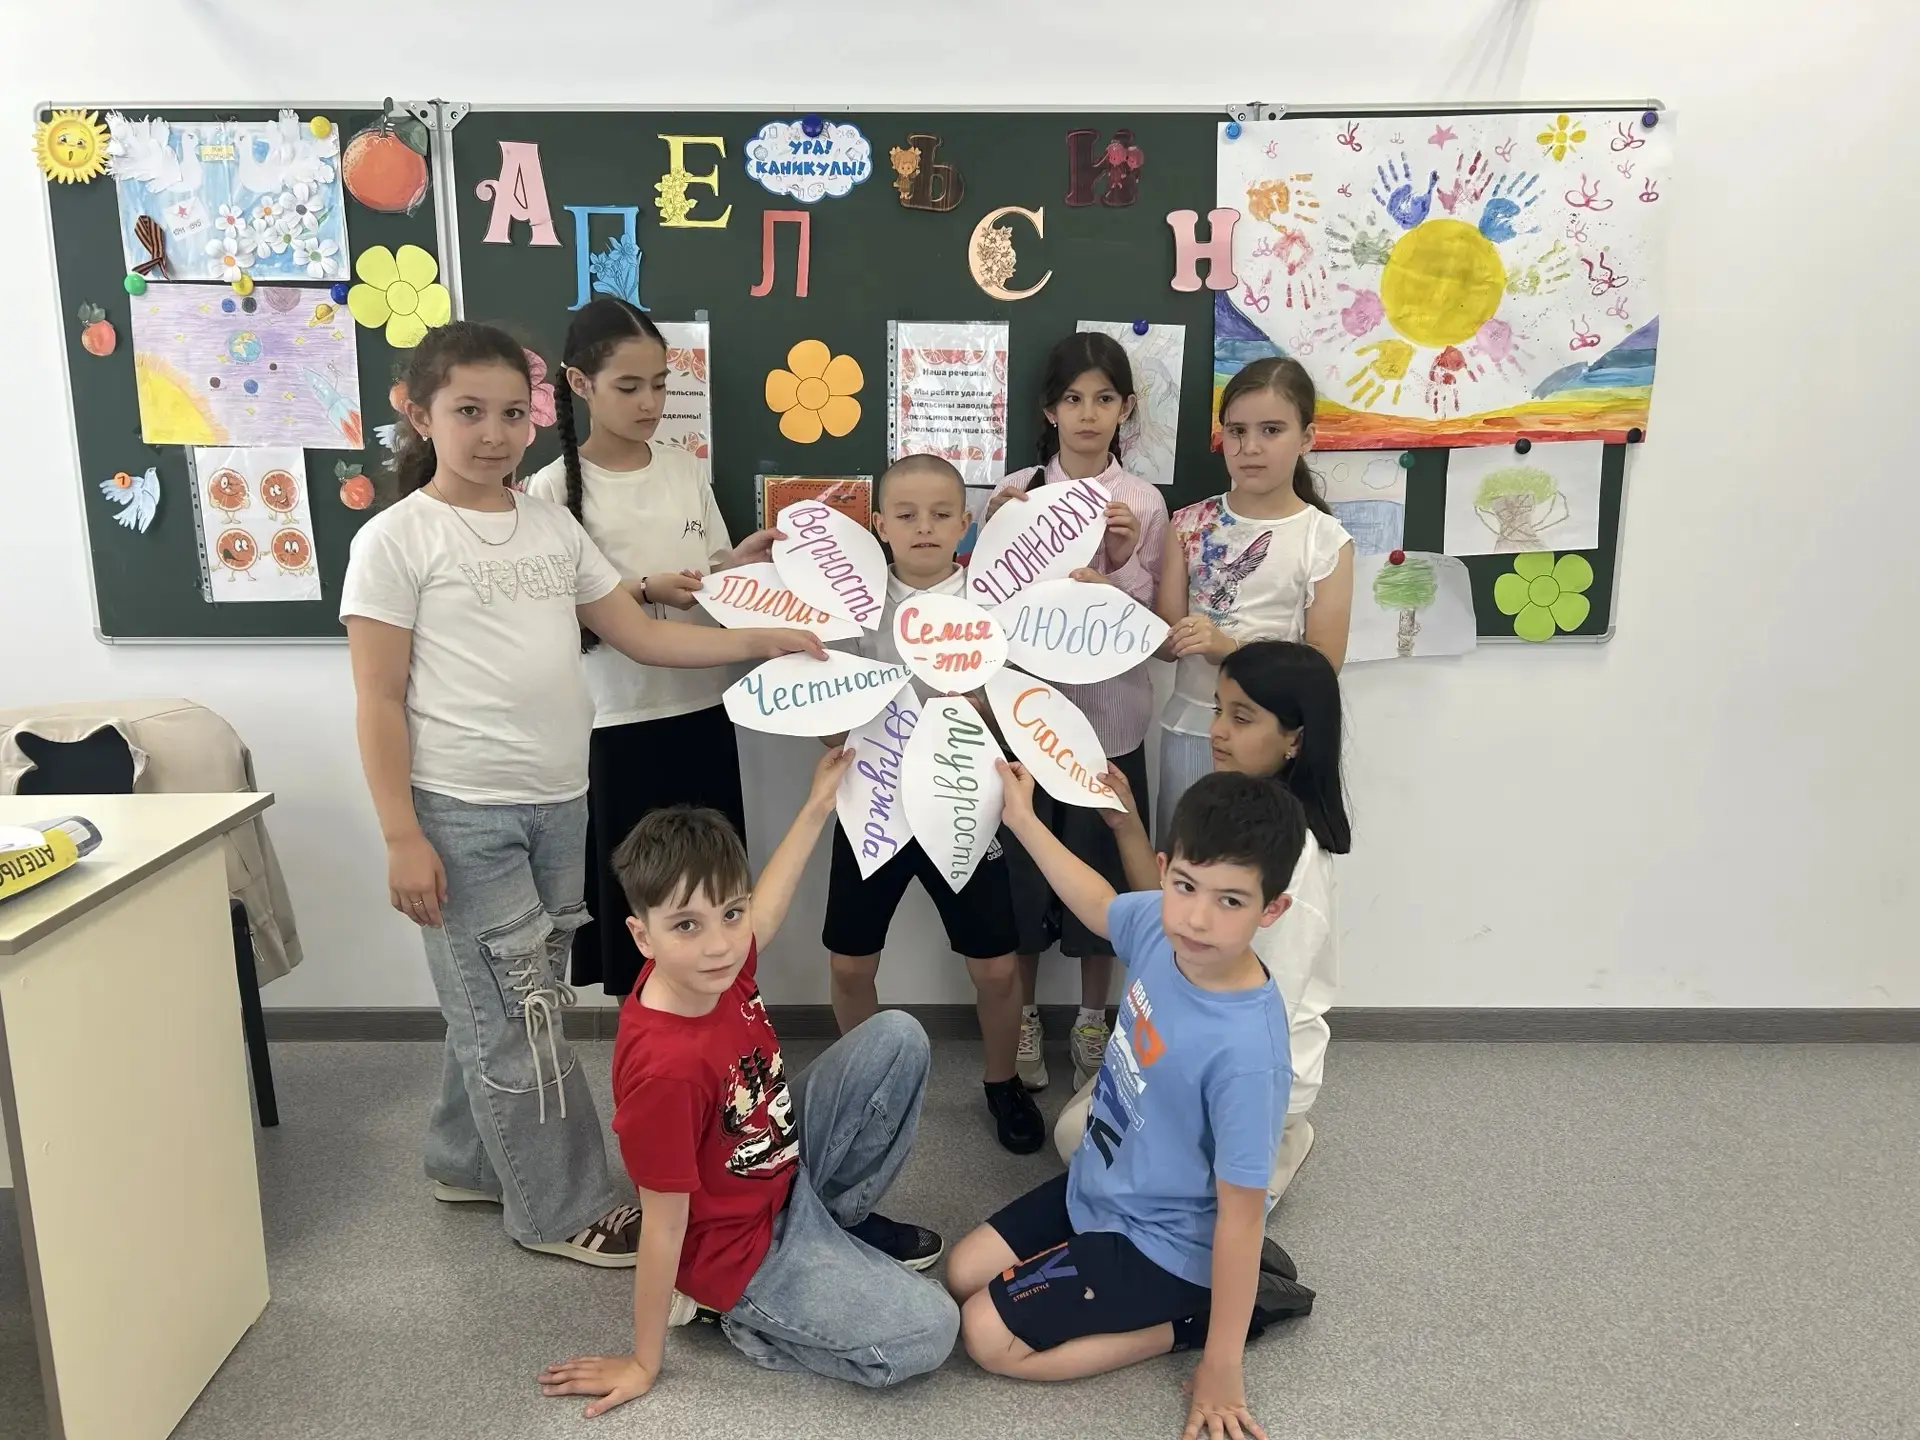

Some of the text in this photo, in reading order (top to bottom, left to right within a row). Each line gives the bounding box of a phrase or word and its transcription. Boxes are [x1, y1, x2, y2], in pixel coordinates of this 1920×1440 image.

[755, 160, 866, 176] КАНИКУЛЫ!
[788, 139, 833, 156] УРА!
[913, 388, 929, 396] Мы
[930, 388, 960, 397] ребята
[922, 368, 947, 376] Наша
[786, 507, 882, 623] Верность
[900, 607, 994, 645] Семья
[739, 665, 912, 716] Честность
[1012, 687, 1114, 798] Счастье
[857, 700, 918, 859] Дружба
[932, 707, 986, 880] Мудрость
[1131, 977, 1154, 1022] URBAN
[1012, 1282, 1050, 1302] STREET STYLE
